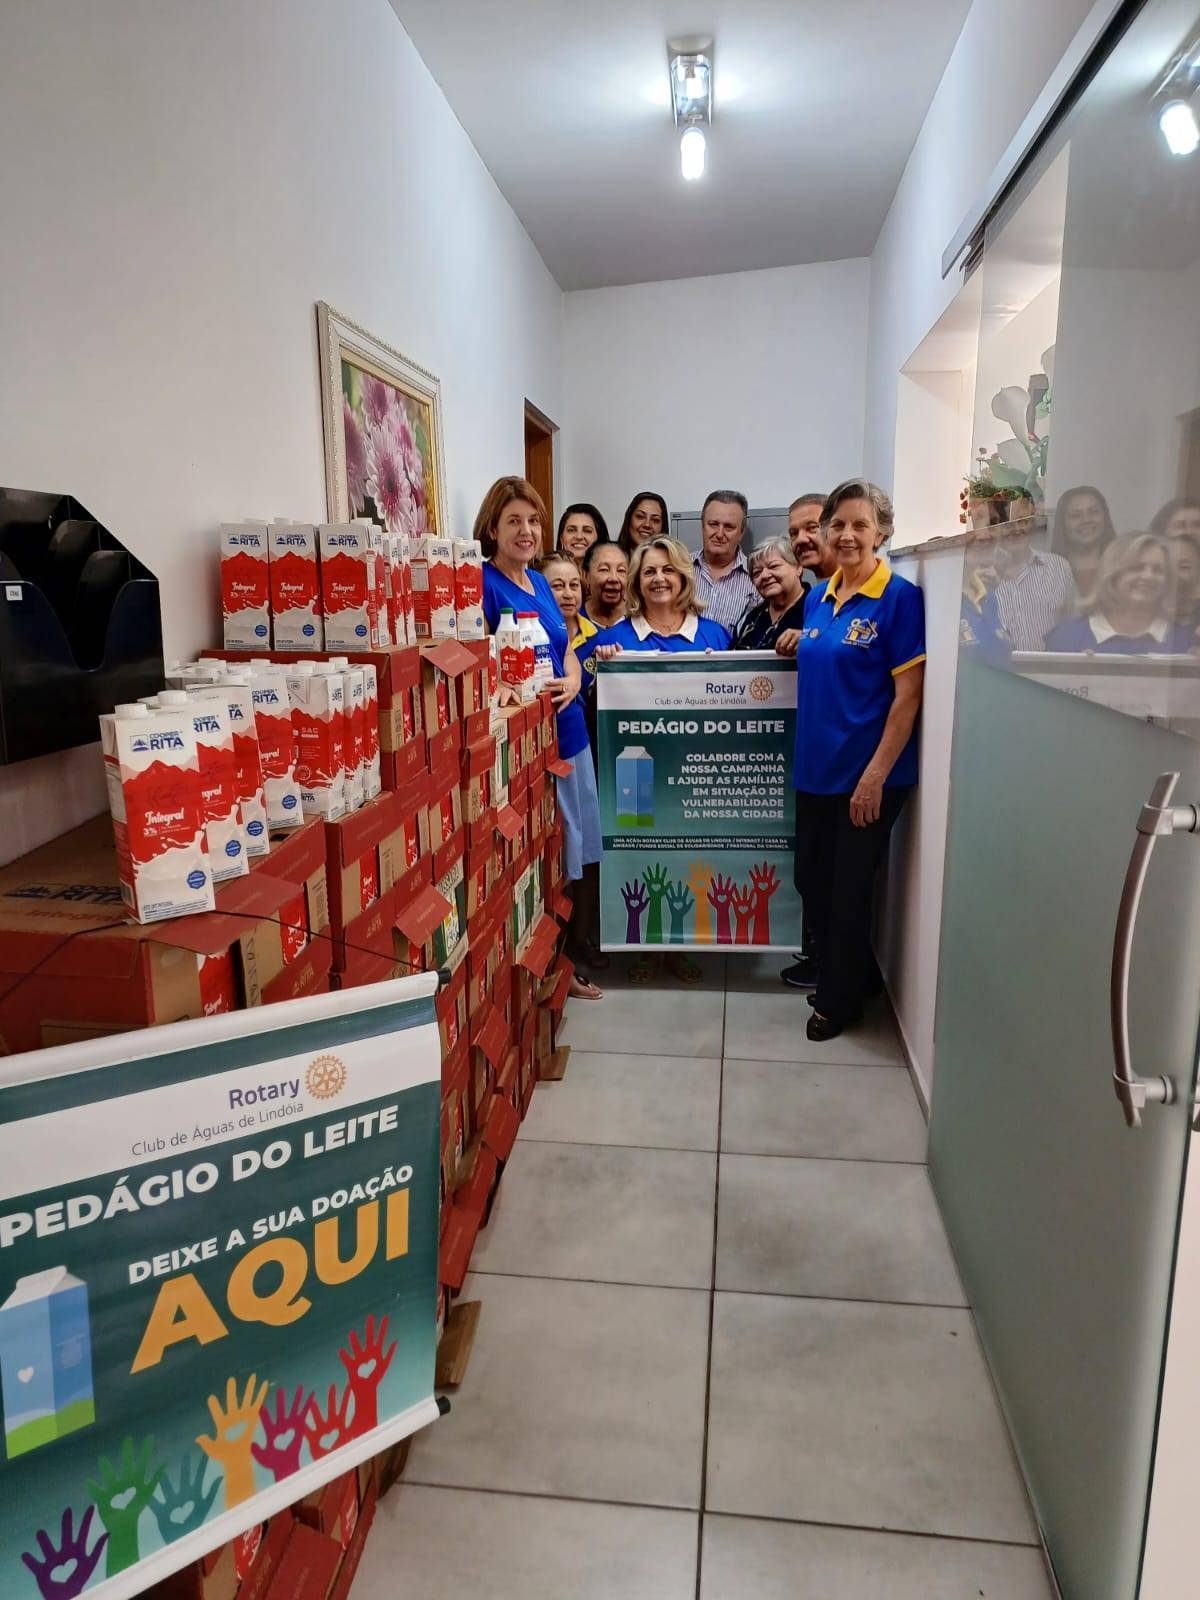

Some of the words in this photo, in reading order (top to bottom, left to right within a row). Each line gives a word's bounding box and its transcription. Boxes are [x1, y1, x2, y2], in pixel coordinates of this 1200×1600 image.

[706, 682, 746, 695] Rotary
[252, 694, 279, 703] RITA
[673, 697, 683, 705] de
[685, 697, 707, 707] Águas
[709, 697, 719, 705] de
[229, 709, 243, 718] TA
[618, 718, 698, 734] PEDÁGIO
[704, 721, 731, 734] DO
[736, 720, 784, 733] LEITE
[150, 731, 180, 739] COOPER
[150, 737, 184, 750] RITA
[686, 753, 745, 762] COLABORE
[749, 753, 773, 761] COM
[777, 753, 784, 761] A
[681, 765, 718, 773] NOSSA
[721, 765, 784, 773] CAMPANHA
[716, 776, 730, 784] AS
[734, 774, 784, 784] FAMÍLIAS
[711, 785, 766, 797] SITUAÇÃO
[682, 799, 784, 807] VULNERABILIDADE
[145, 808, 185, 826] Integral
[684, 810, 700, 818] DA
[703, 810, 739, 818] NOSSA
[742, 810, 784, 818] CIDADE
[229, 1079, 300, 1109] Rotary
[132, 1138, 166, 1156] Club
[170, 1132, 188, 1146] de
[192, 1124, 235, 1142] Águas
[238, 1114, 256, 1128] de
[259, 1102, 304, 1123] Lindóia
[0, 1163, 219, 1249] PEDÁGIO
[232, 1140, 291, 1182] DO
[304, 1105, 399, 1158] LEITE
[129, 1237, 218, 1285] DEIXE
[225, 1229, 246, 1251] A
[253, 1210, 305, 1239] SUA
[311, 1165, 413, 1218] DOAÇÃO
[130, 1188, 410, 1374] AQUI
